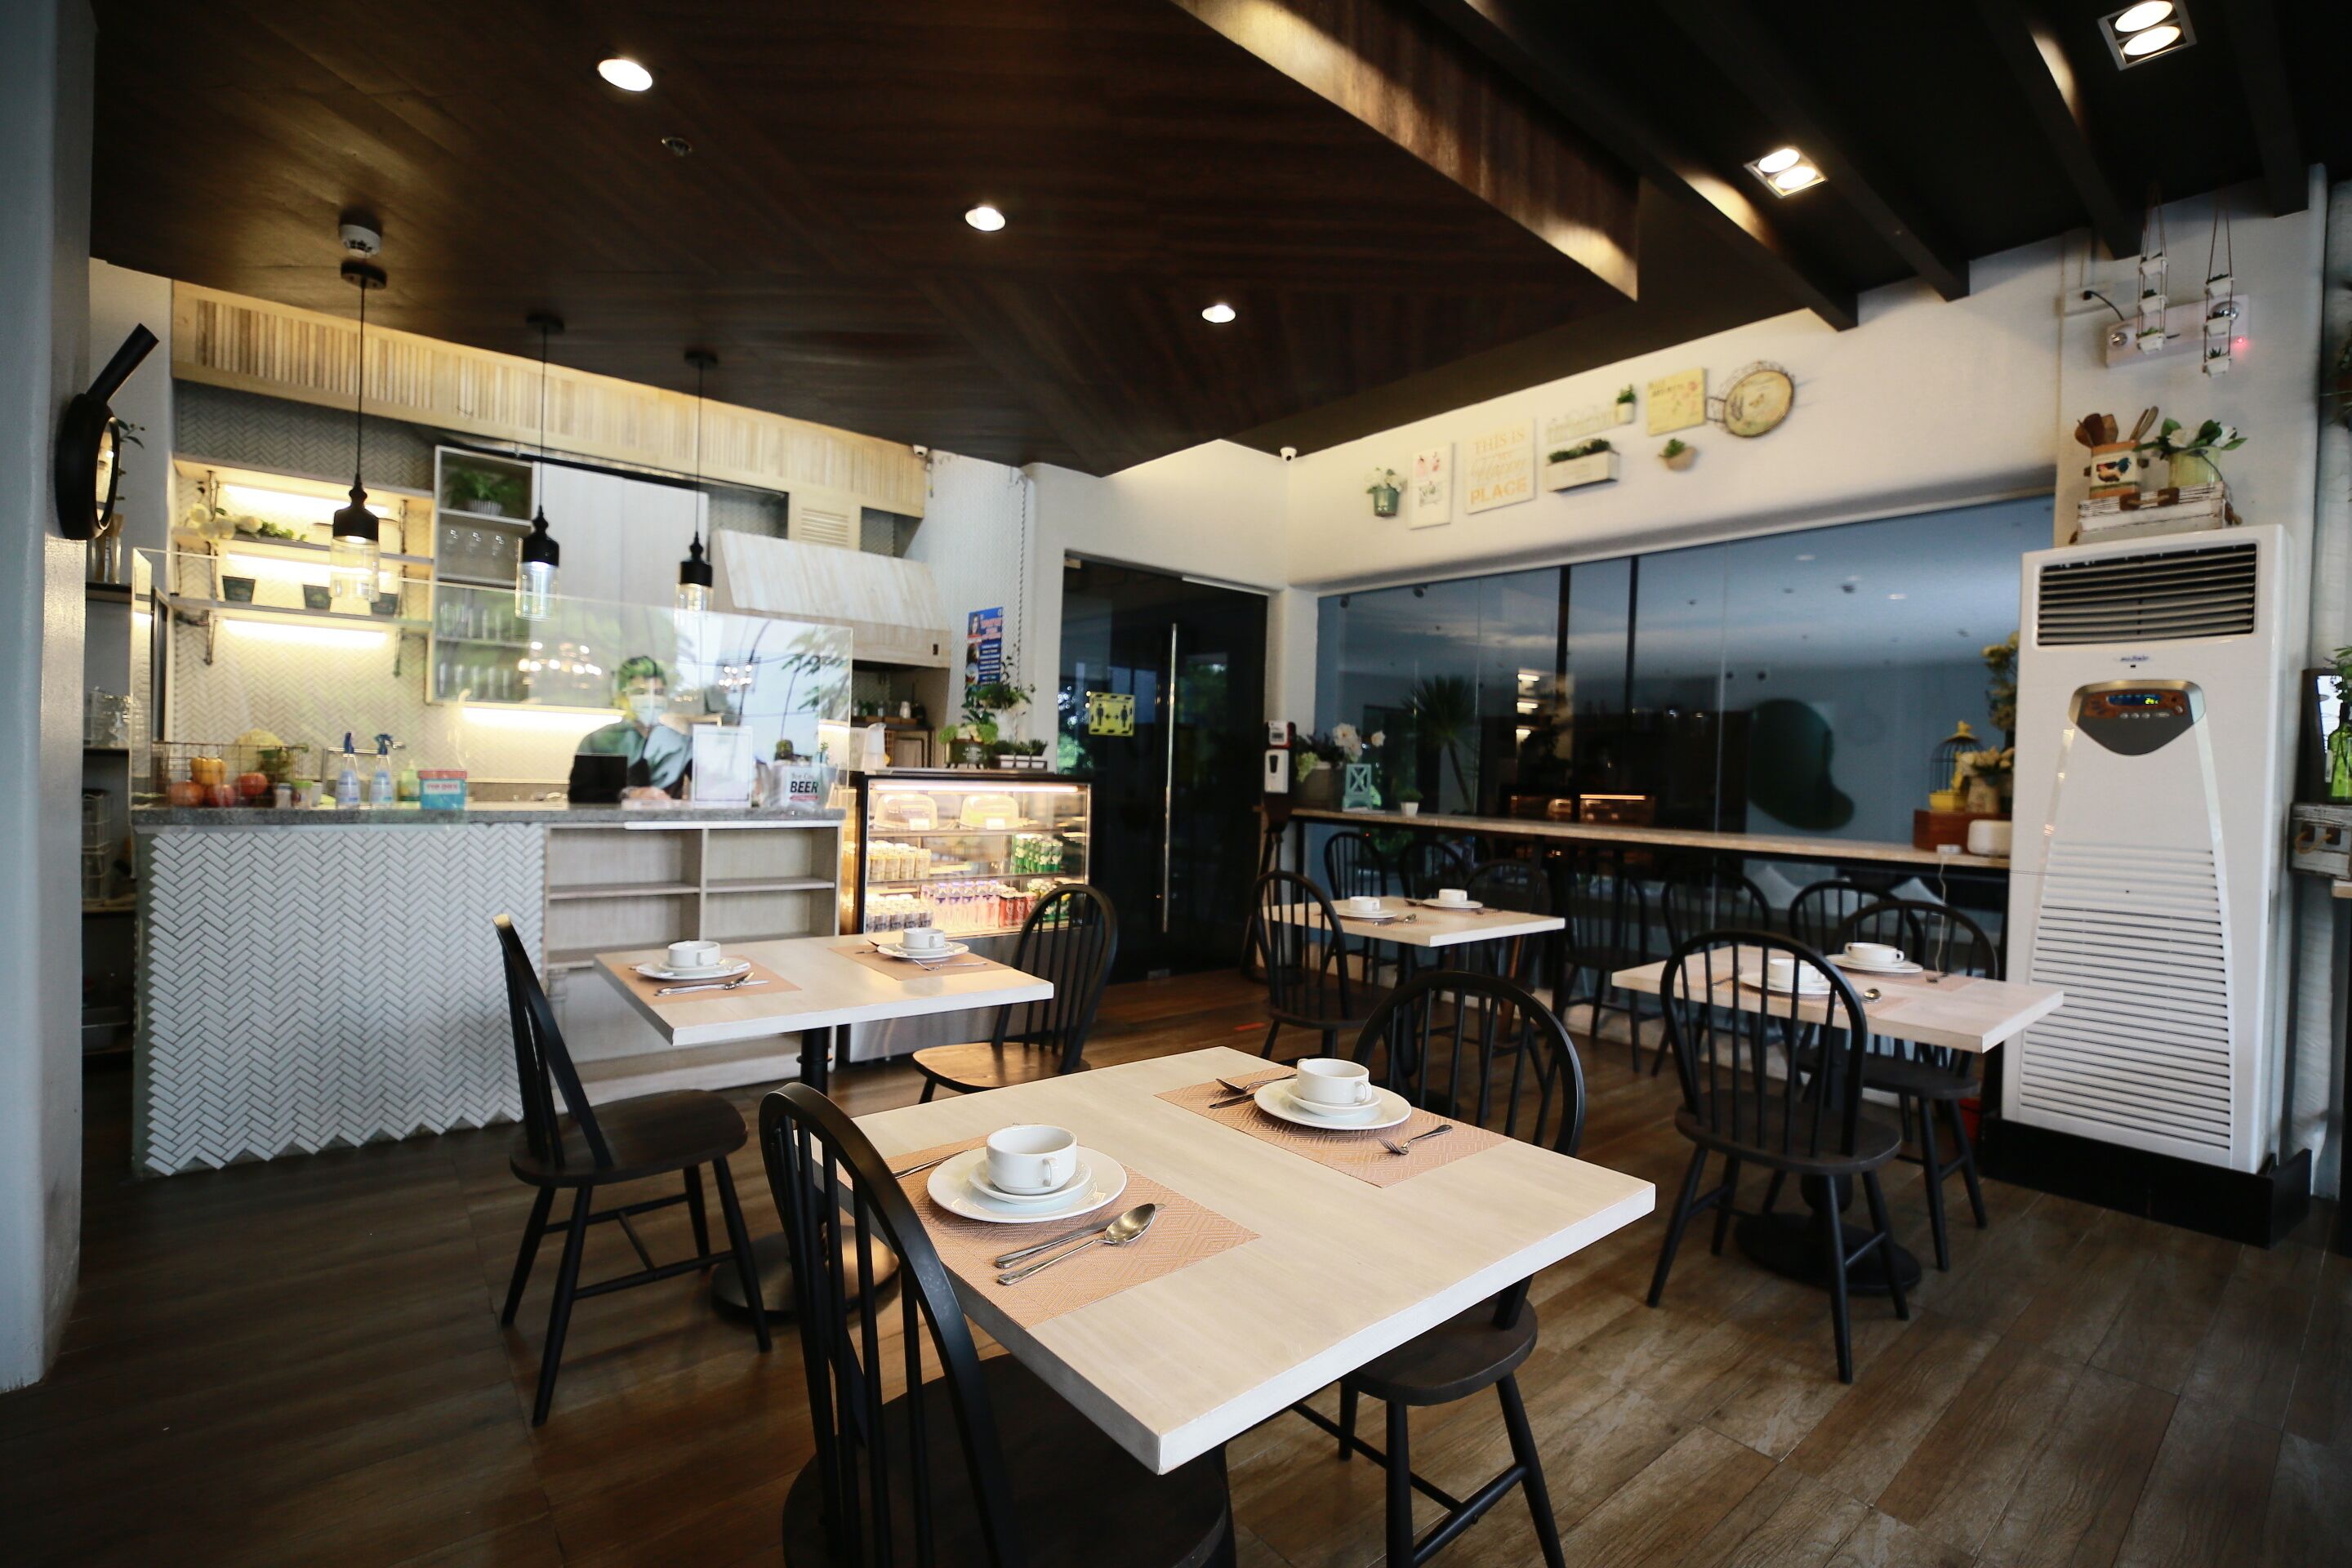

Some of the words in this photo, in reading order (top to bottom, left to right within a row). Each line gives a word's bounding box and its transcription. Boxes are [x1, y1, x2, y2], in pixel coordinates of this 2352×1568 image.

[1472, 433, 1507, 454] THIS
[1511, 426, 1526, 444] IS
[1470, 476, 1527, 505] PLACE
[790, 781, 819, 793] BEER
